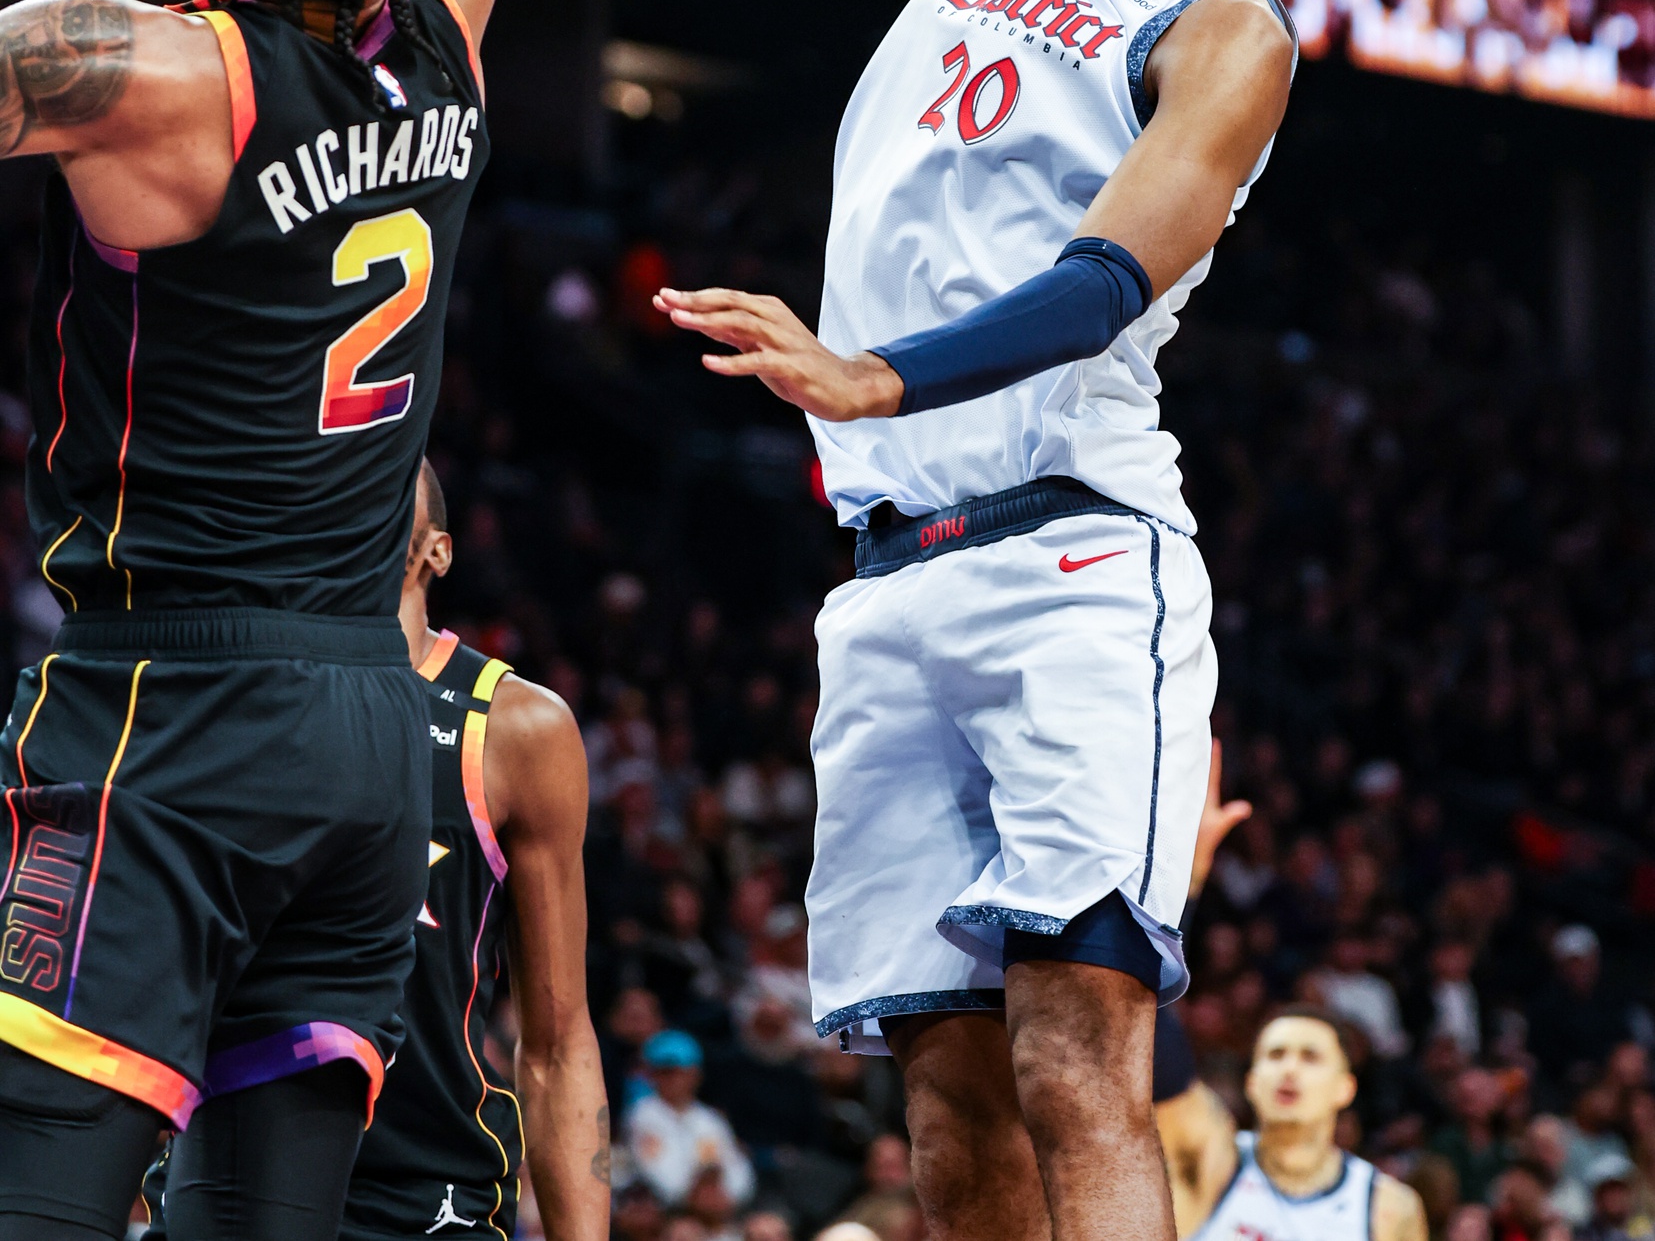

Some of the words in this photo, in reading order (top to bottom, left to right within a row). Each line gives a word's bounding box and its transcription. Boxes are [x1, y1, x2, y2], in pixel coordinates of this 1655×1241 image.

[937, 5, 957, 17] OF
[967, 13, 1082, 71] COLUMBIA
[918, 40, 1021, 146] 20
[257, 104, 479, 235] RICHARDS
[318, 207, 434, 435] 2
[919, 515, 966, 549] DMV
[440, 689, 455, 703] AL
